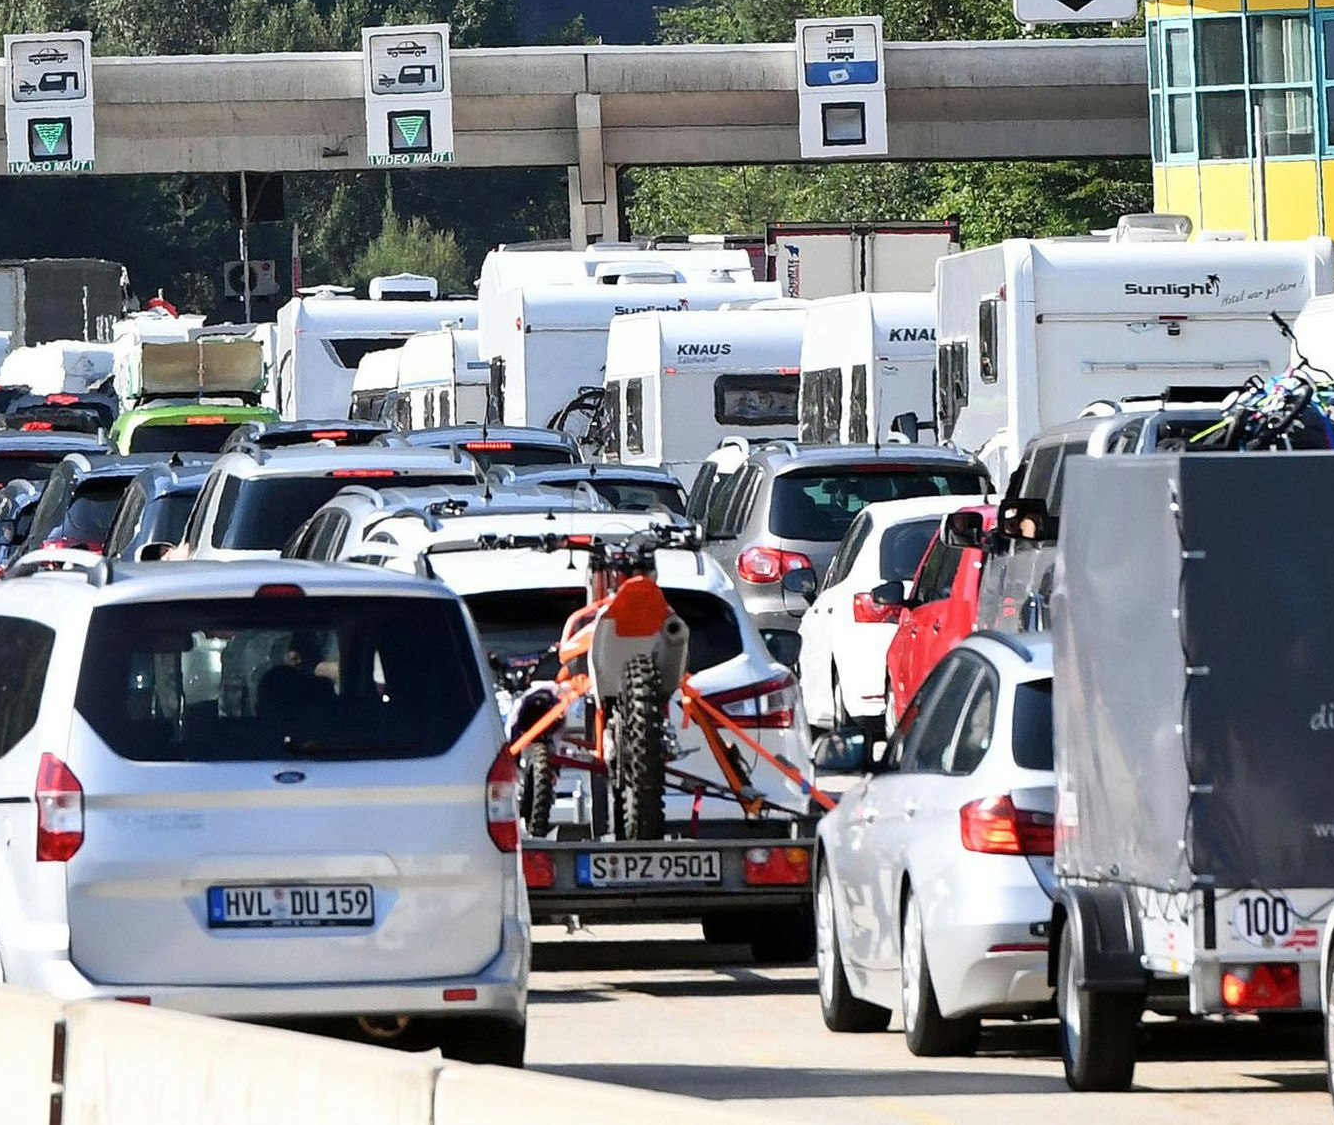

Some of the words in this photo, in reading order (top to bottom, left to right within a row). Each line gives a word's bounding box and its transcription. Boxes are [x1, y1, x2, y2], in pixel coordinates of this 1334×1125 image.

[15, 161, 52, 173] VIDEO
[54, 160, 88, 171] MAUT
[375, 154, 410, 165] VIDEO
[413, 152, 448, 164] MAUT
[1125, 283, 1212, 299] Sunlight
[677, 344, 731, 355] KNAUS
[593, 857, 607, 879] S
[625, 857, 653, 878] PZ
[659, 855, 717, 877] 9501
[227, 890, 271, 916] HVL
[291, 890, 319, 915] DU
[327, 890, 367, 915] 159
[1239, 897, 1289, 937] 100
